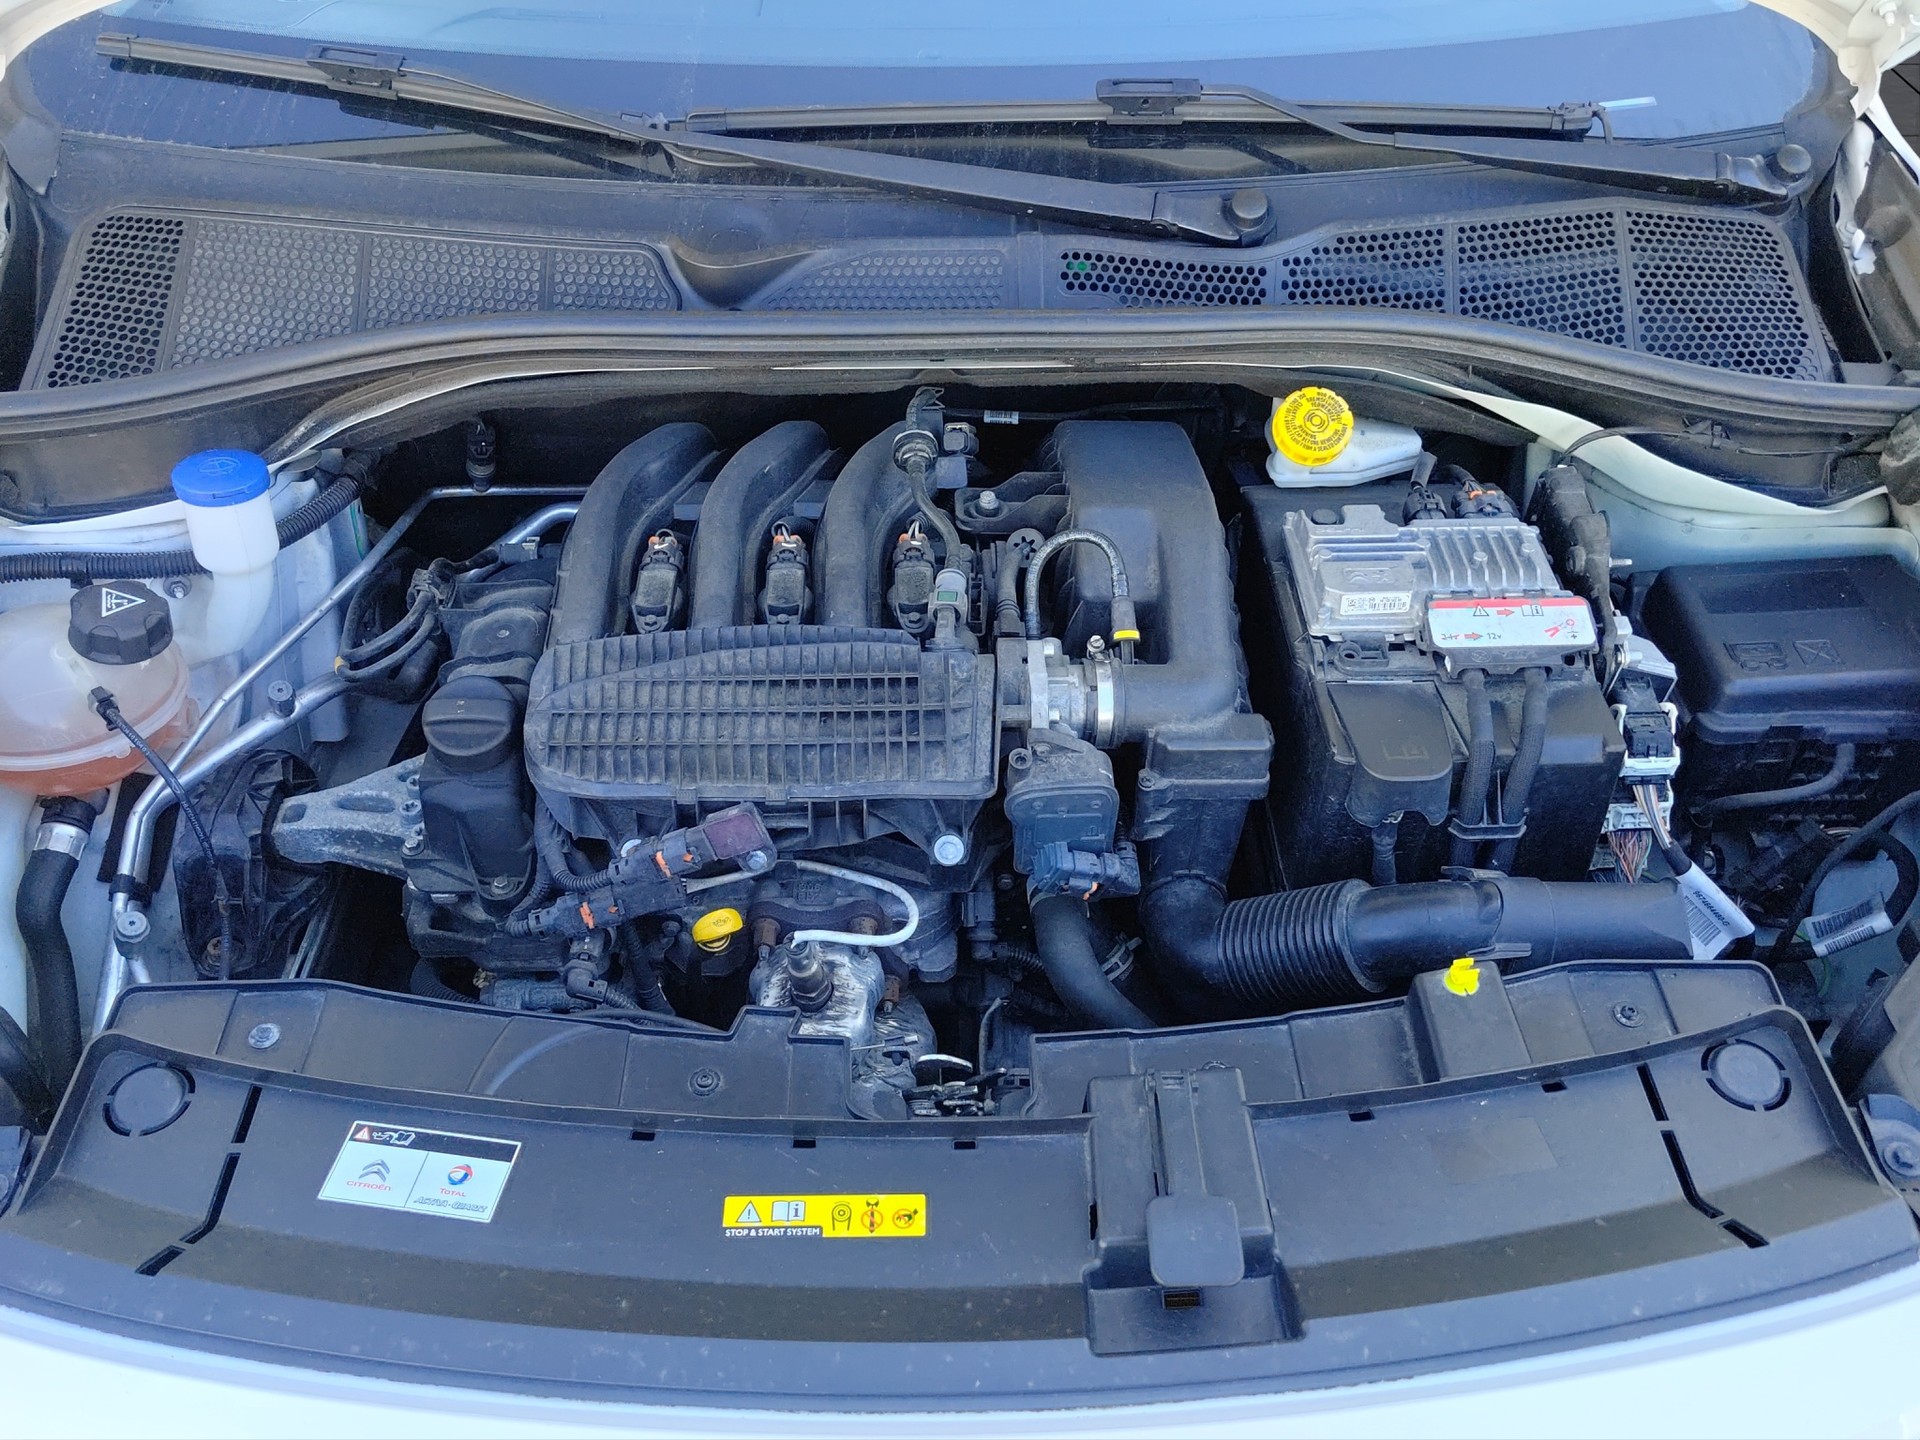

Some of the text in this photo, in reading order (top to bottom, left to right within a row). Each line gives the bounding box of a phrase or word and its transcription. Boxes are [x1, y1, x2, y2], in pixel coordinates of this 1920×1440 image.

[1294, 430, 1303, 440] CAP
[439, 1187, 467, 1198] TOTAL
[725, 1227, 820, 1237] STOP & START SYSTEM
